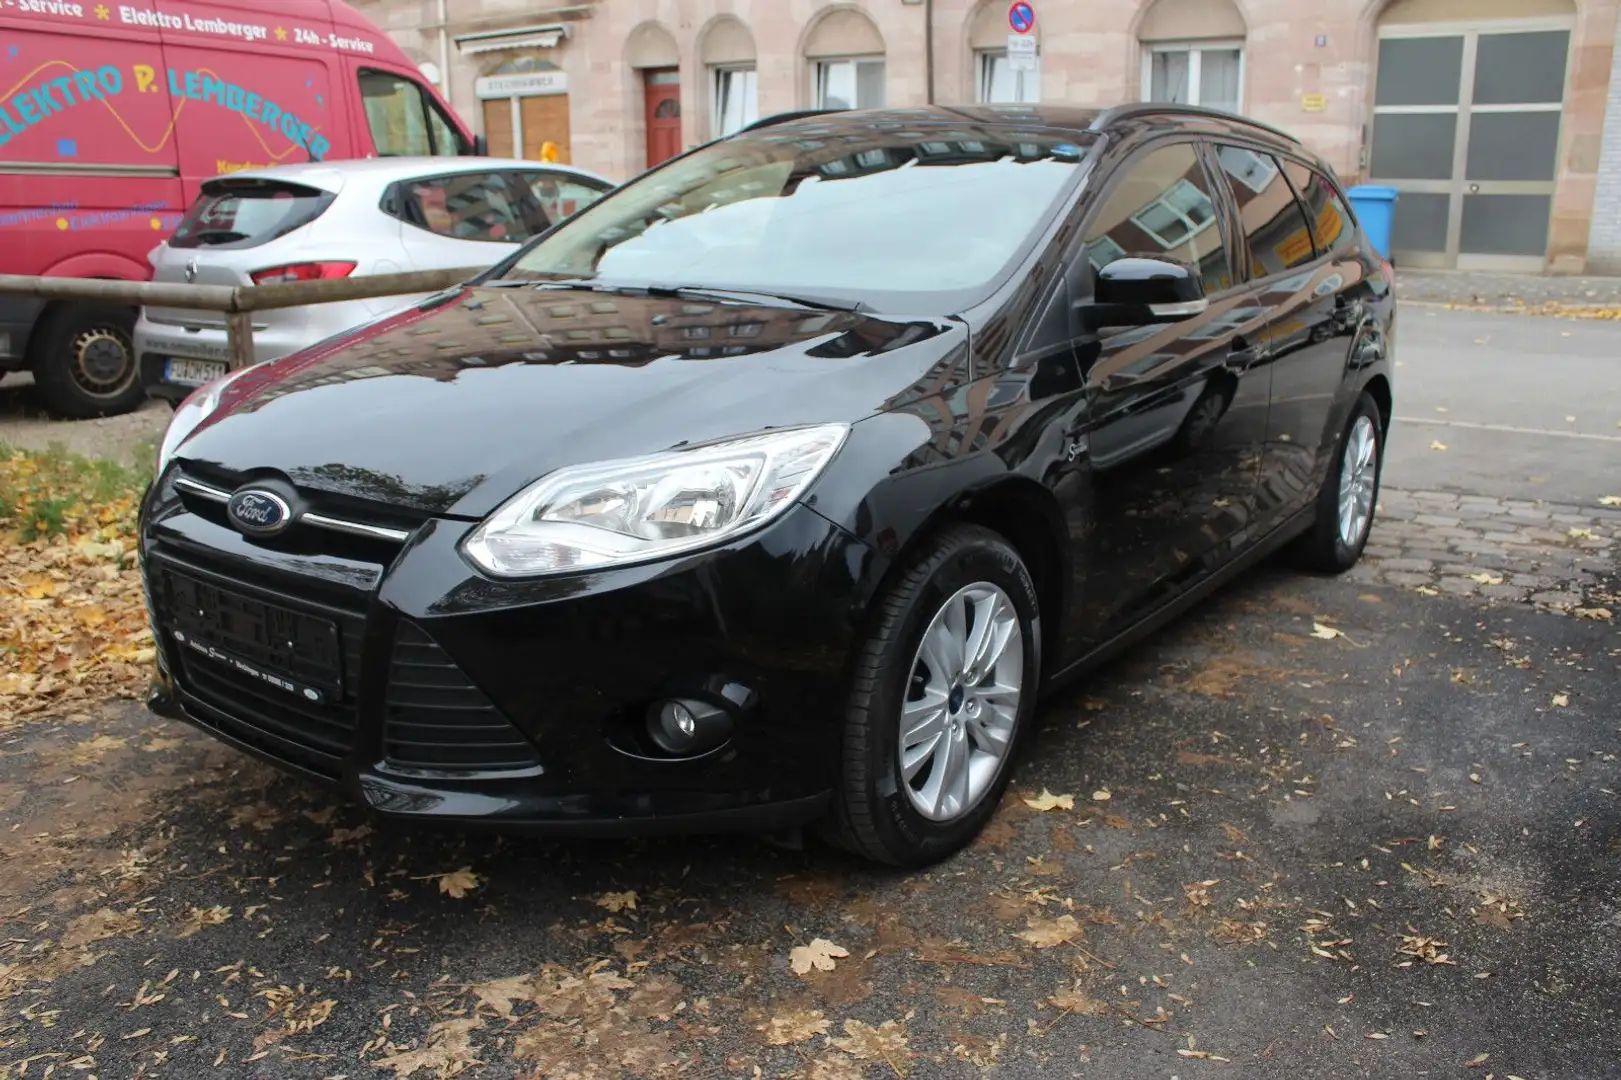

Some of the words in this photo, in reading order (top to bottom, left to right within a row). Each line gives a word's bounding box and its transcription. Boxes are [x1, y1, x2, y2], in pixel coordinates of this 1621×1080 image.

[19, 0, 84, 18] Service
[119, 6, 183, 30] Elektro
[184, 14, 268, 41] Lemberger
[133, 63, 159, 93] P.
[167, 67, 330, 162] LEMBERGER
[236, 494, 272, 523] Ford
